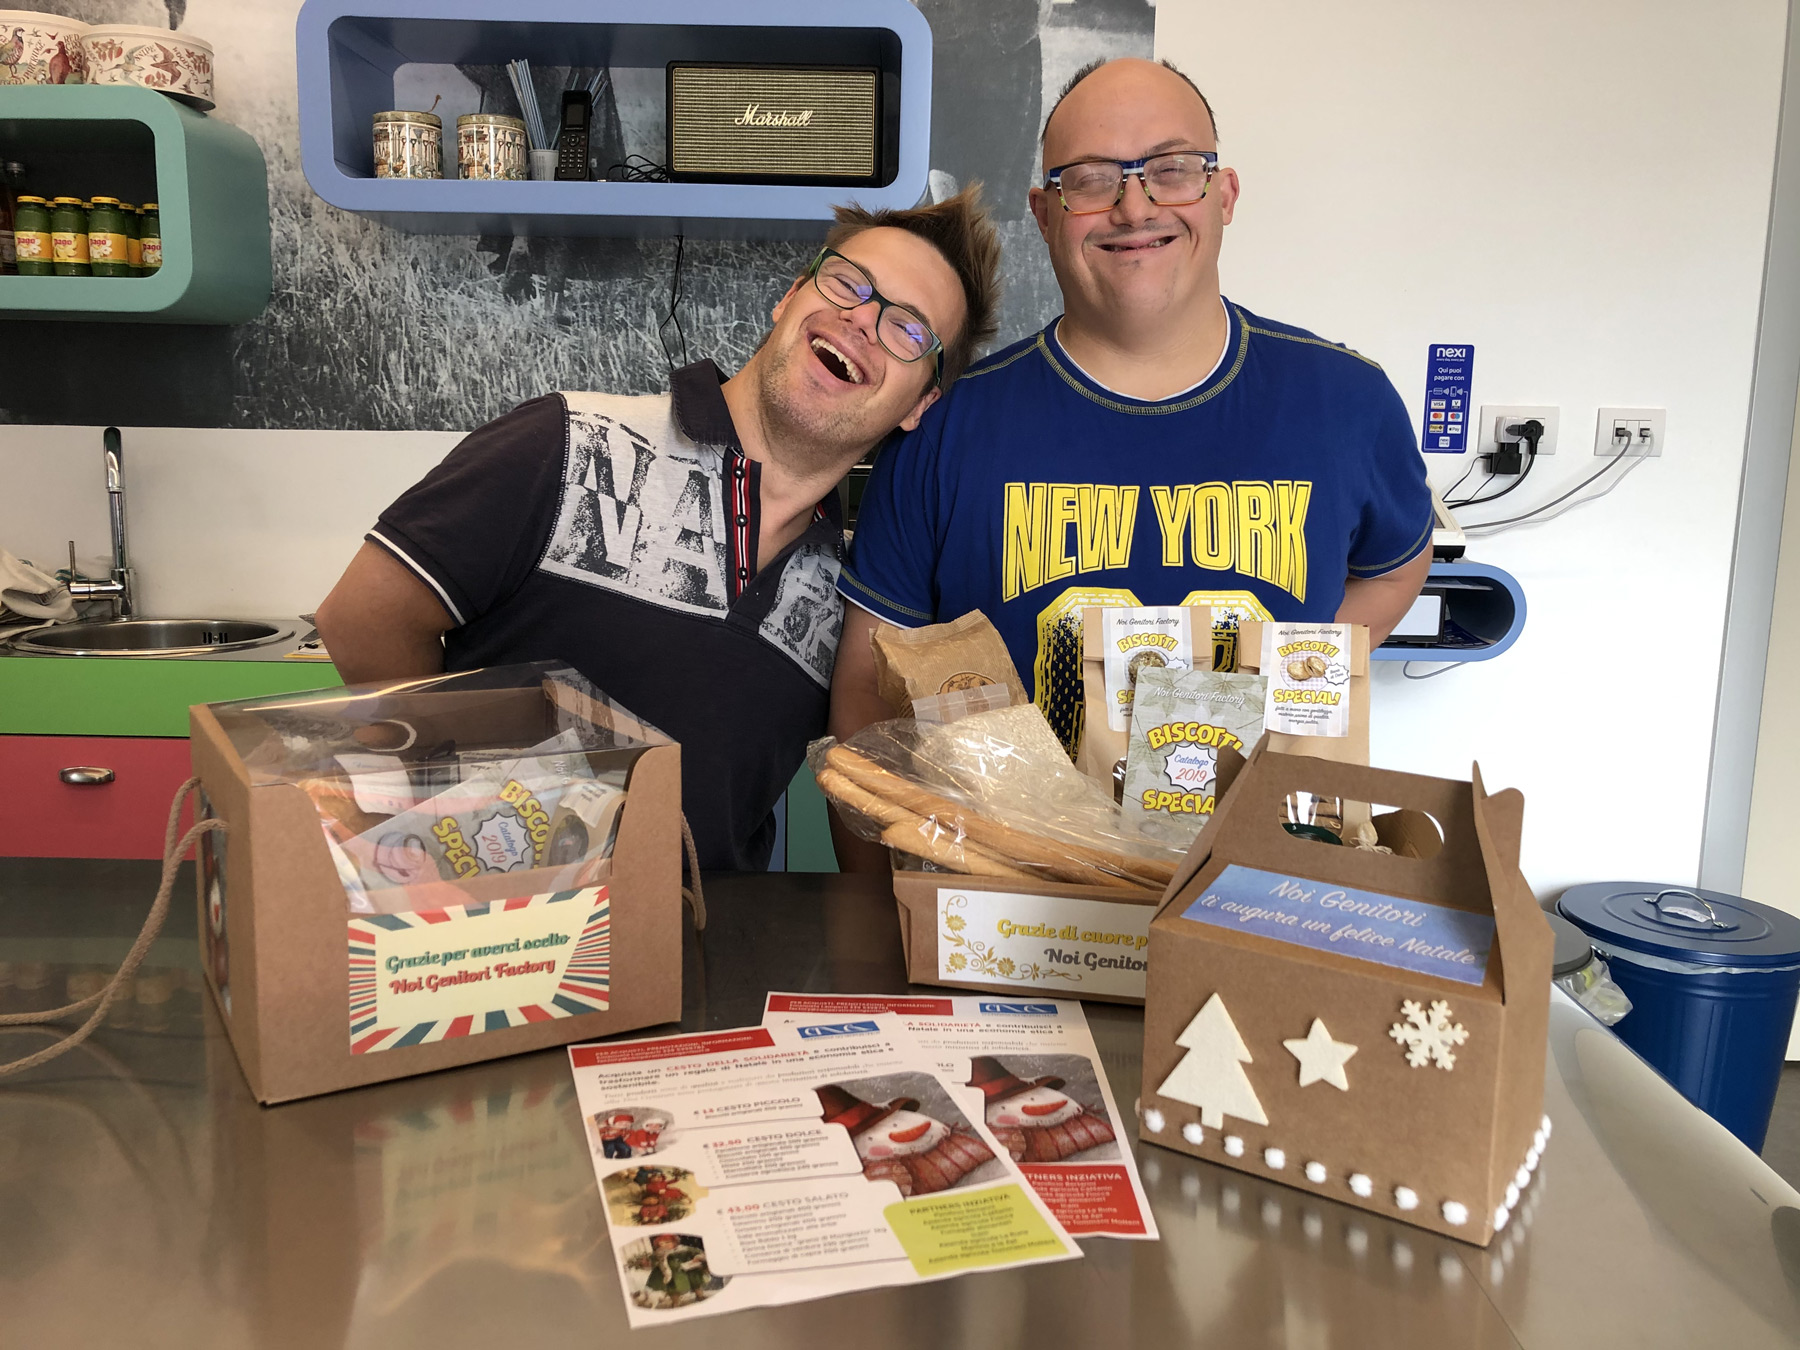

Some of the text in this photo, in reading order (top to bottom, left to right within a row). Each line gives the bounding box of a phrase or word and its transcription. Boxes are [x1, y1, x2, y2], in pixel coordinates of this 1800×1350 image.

[134, 45, 156, 61] SNIPE
[734, 104, 814, 127] Marshall
[17, 237, 36, 245] pago
[53, 238, 73, 246] pago
[89, 238, 107, 246] pago
[1436, 347, 1466, 358] nexi
[1002, 480, 1313, 604] NEW YORK
[1155, 618, 1179, 627] Factory
[1317, 629, 1342, 637] Factory
[1117, 633, 1178, 653] BISCOTTI
[1277, 640, 1340, 658] BISCOTTI
[1153, 687, 1245, 706] Noi Genitori Factory
[1273, 688, 1341, 706] SPECIALI
[1174, 754, 1209, 769] Catalogo
[1175, 768, 1207, 782] 2019
[1142, 789, 1216, 815] SPECIA
[499, 779, 551, 869] BISCO
[433, 816, 481, 879] SPECI
[498, 821, 519, 857] Catalogo
[481, 835, 507, 864] 2019
[1268, 880, 1427, 928] Noi Genitori
[997, 919, 1057, 938] Grazie
[1058, 925, 1079, 941] di
[1081, 931, 1134, 947] cuore
[1201, 893, 1477, 965] ti augura un felice Natale
[385, 933, 570, 974] Grazie per averci scelto
[1044, 948, 1148, 971] Noi Genito
[389, 960, 556, 994] Noi Genitori Factory
[705, 1058, 739, 1066] DELLA
[743, 1050, 809, 1061] SOLIDARIETÀ
[715, 1103, 752, 1111] CESTO
[746, 1133, 783, 1142] CESTO
